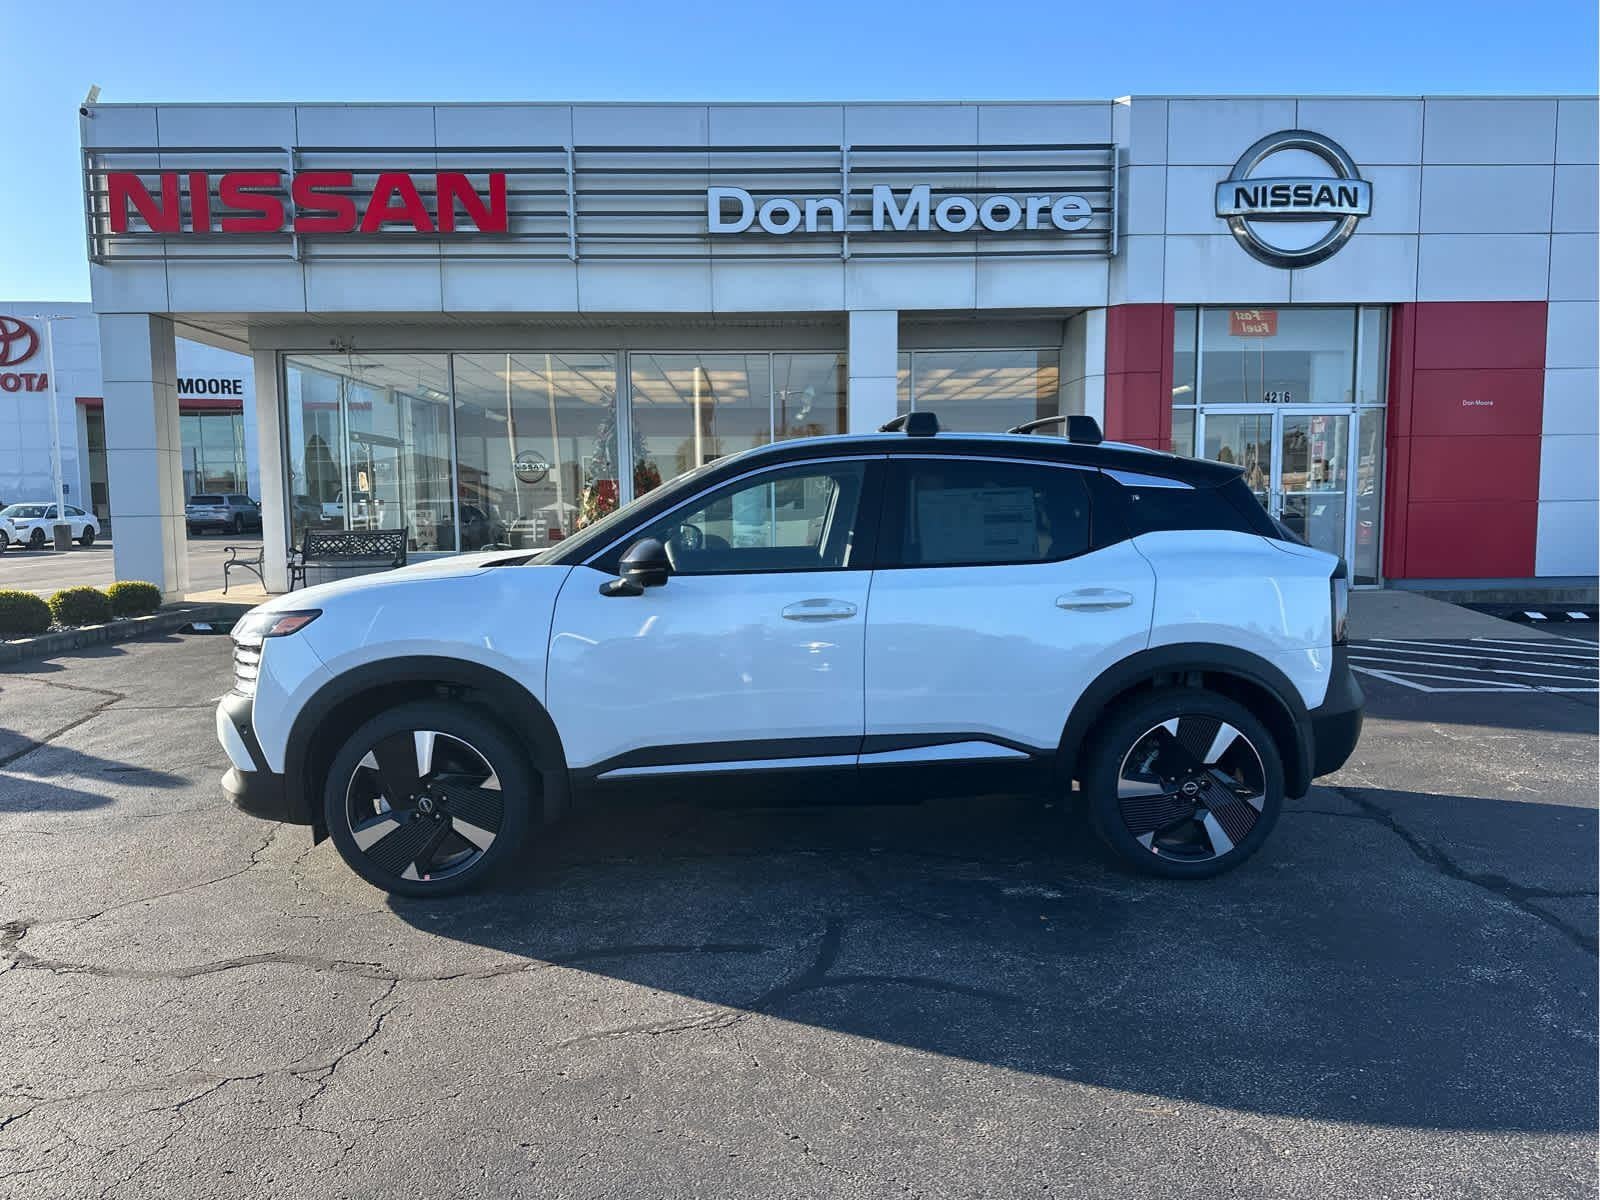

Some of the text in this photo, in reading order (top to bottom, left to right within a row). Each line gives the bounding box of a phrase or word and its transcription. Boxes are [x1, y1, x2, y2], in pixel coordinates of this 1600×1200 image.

[107, 172, 508, 233] NISSAN
[1234, 184, 1359, 209] NISSAN
[707, 184, 1093, 235] Don Moore
[0, 372, 49, 393] OTA
[177, 378, 243, 395] MOORE
[1264, 391, 1291, 404] 4216
[1462, 399, 1494, 407] Don Moore
